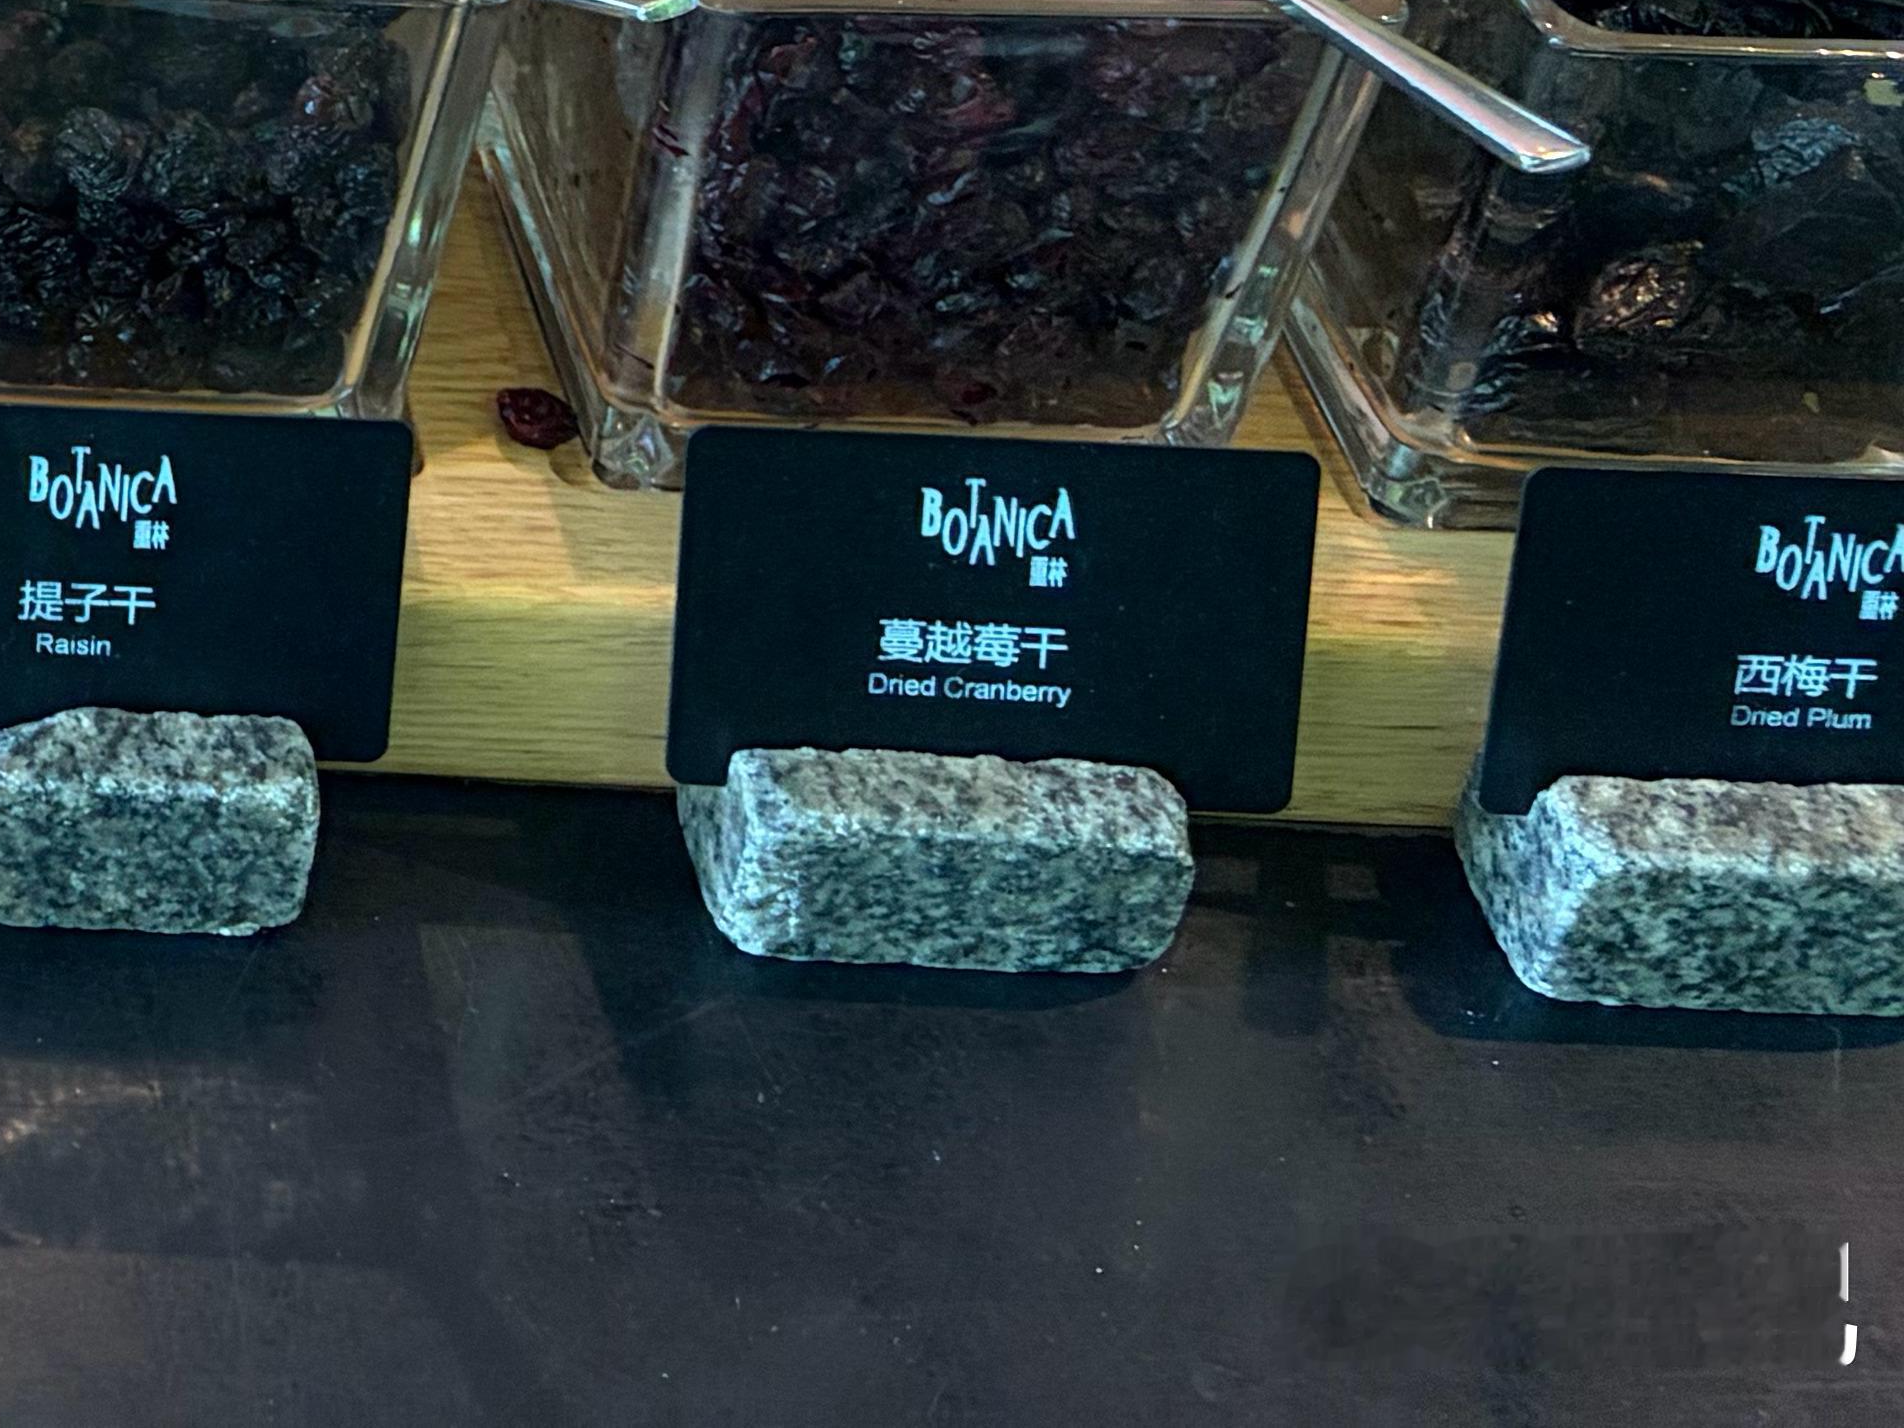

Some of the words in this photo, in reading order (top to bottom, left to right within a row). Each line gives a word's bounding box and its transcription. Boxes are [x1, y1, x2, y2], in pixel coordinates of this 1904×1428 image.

[29, 446, 177, 529] BOTANICA
[920, 478, 1075, 565] BOTANICA
[1755, 515, 1904, 600] BOTANICA
[18, 580, 156, 625] 提子干
[36, 633, 111, 656] Raisin
[878, 618, 1069, 669] 蔓越莓干
[868, 673, 936, 697] Dried
[944, 676, 1072, 708] Cranberry
[1734, 654, 1878, 699] 西梅干
[1730, 705, 1800, 727] Dried
[1806, 707, 1872, 729] Plum
